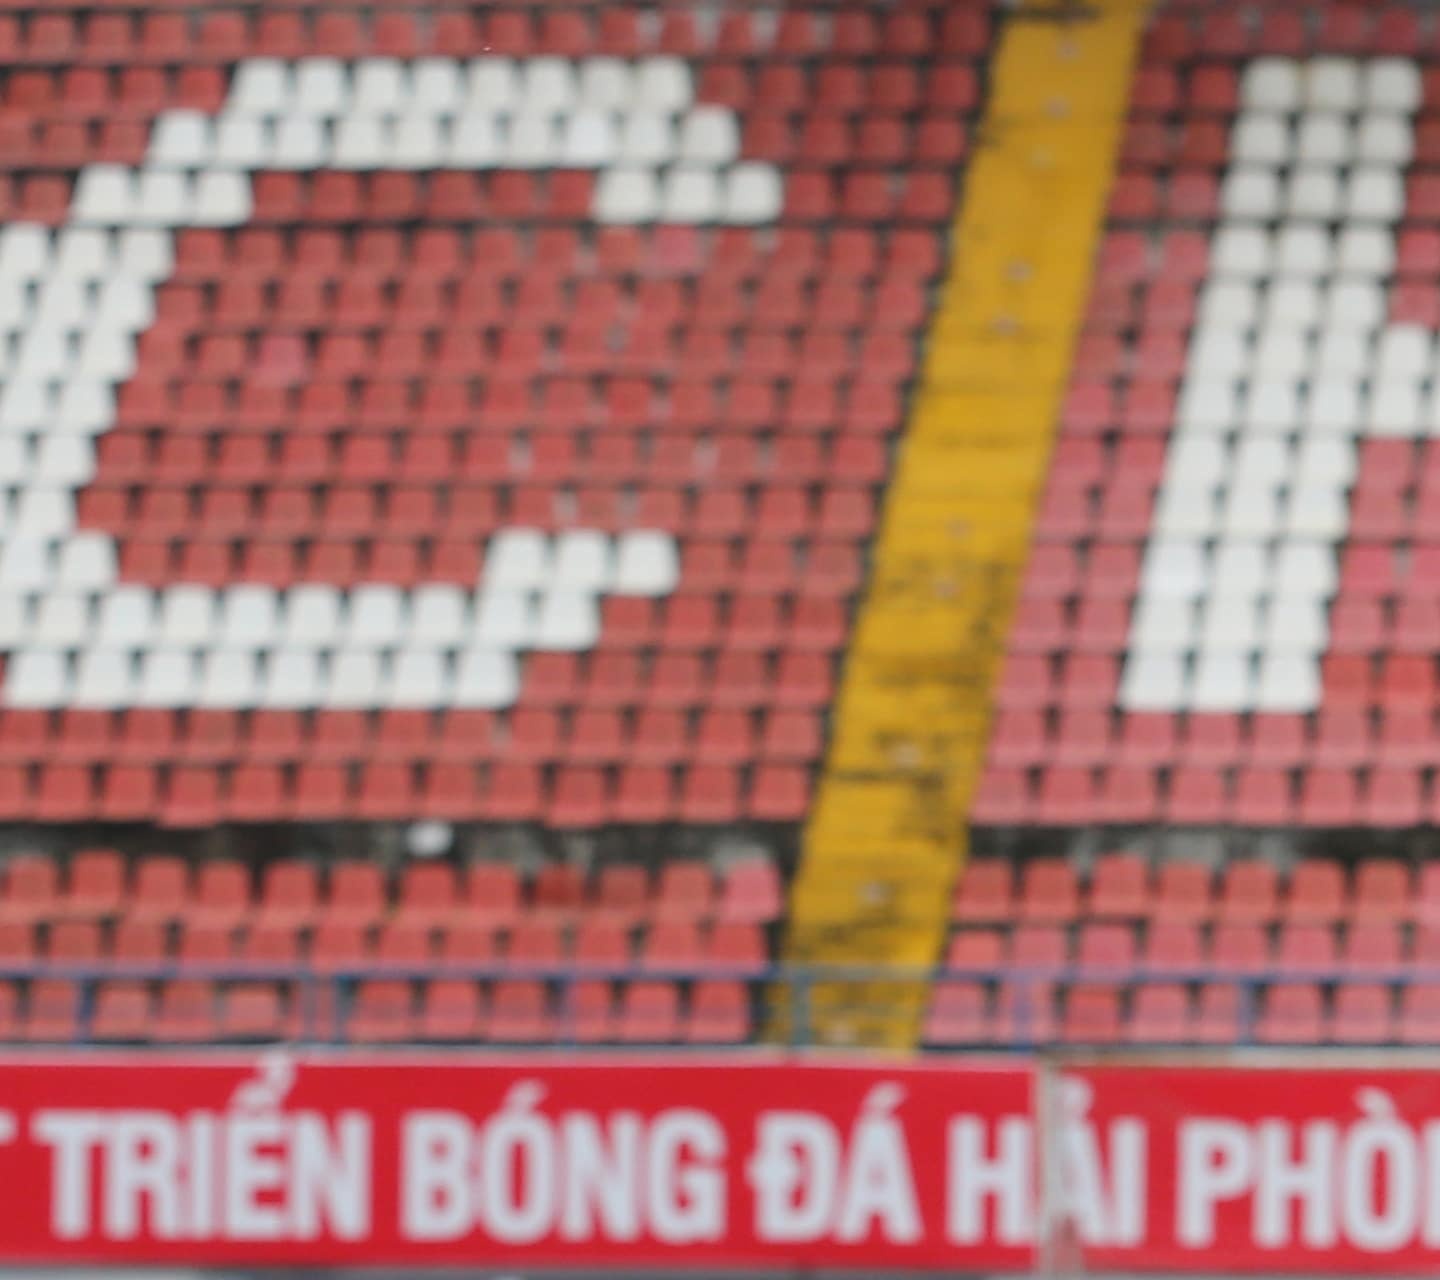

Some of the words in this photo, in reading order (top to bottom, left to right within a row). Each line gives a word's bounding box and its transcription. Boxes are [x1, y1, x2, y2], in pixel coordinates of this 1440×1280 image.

[33, 1048, 372, 1242] TRIỂN
[401, 1079, 728, 1244] BÓNG
[747, 1081, 923, 1244] ĐÁ
[946, 1077, 1148, 1249] HẢI
